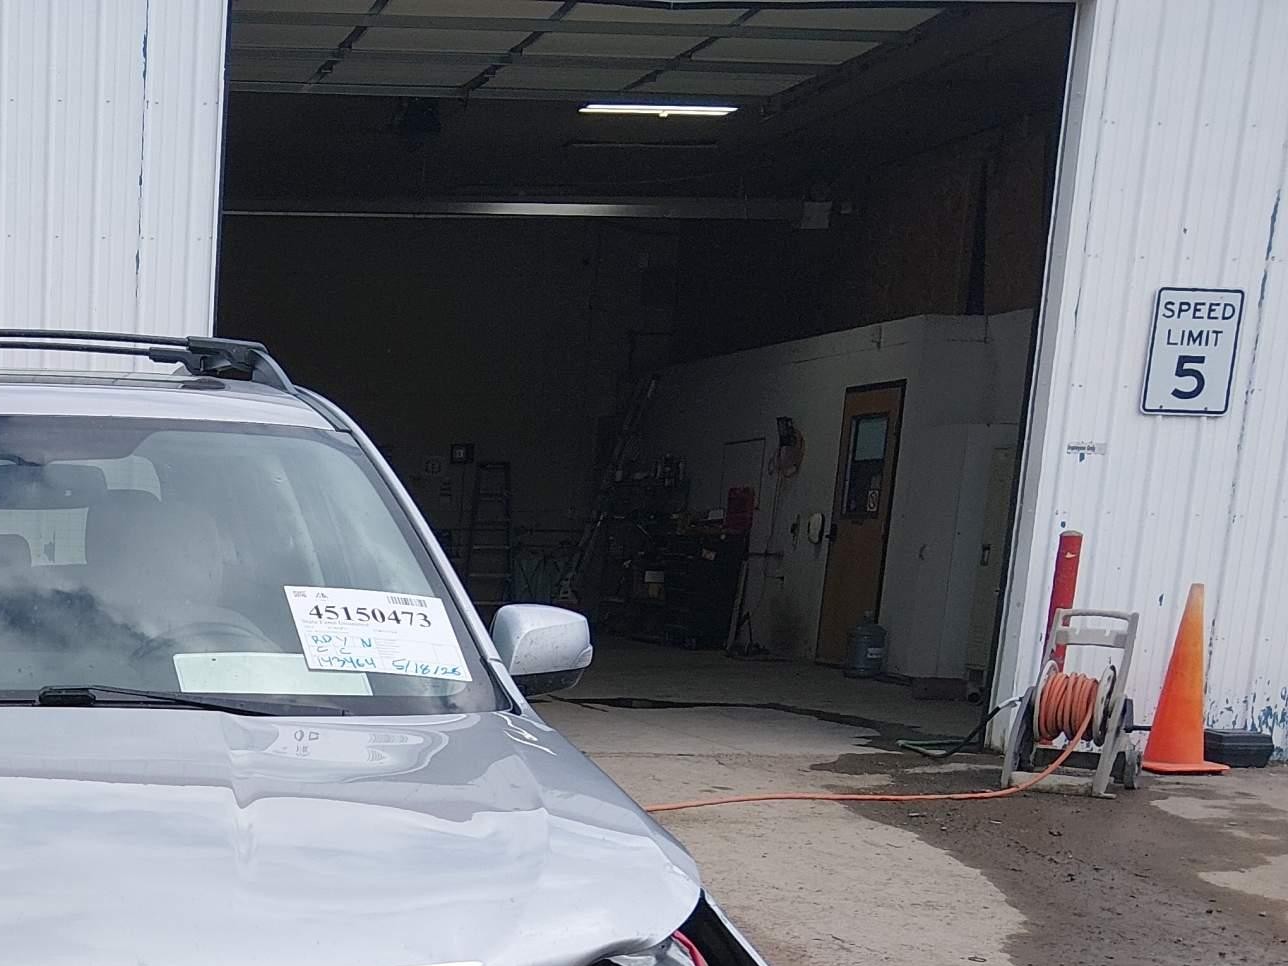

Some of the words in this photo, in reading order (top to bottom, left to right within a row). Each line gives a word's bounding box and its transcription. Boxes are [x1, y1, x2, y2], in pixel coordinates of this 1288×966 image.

[1162, 301, 1236, 321] SPEED
[1166, 328, 1223, 347] LIMIT
[1171, 355, 1206, 400] 5
[309, 604, 431, 627] 45150473
[360, 638, 372, 648] N
